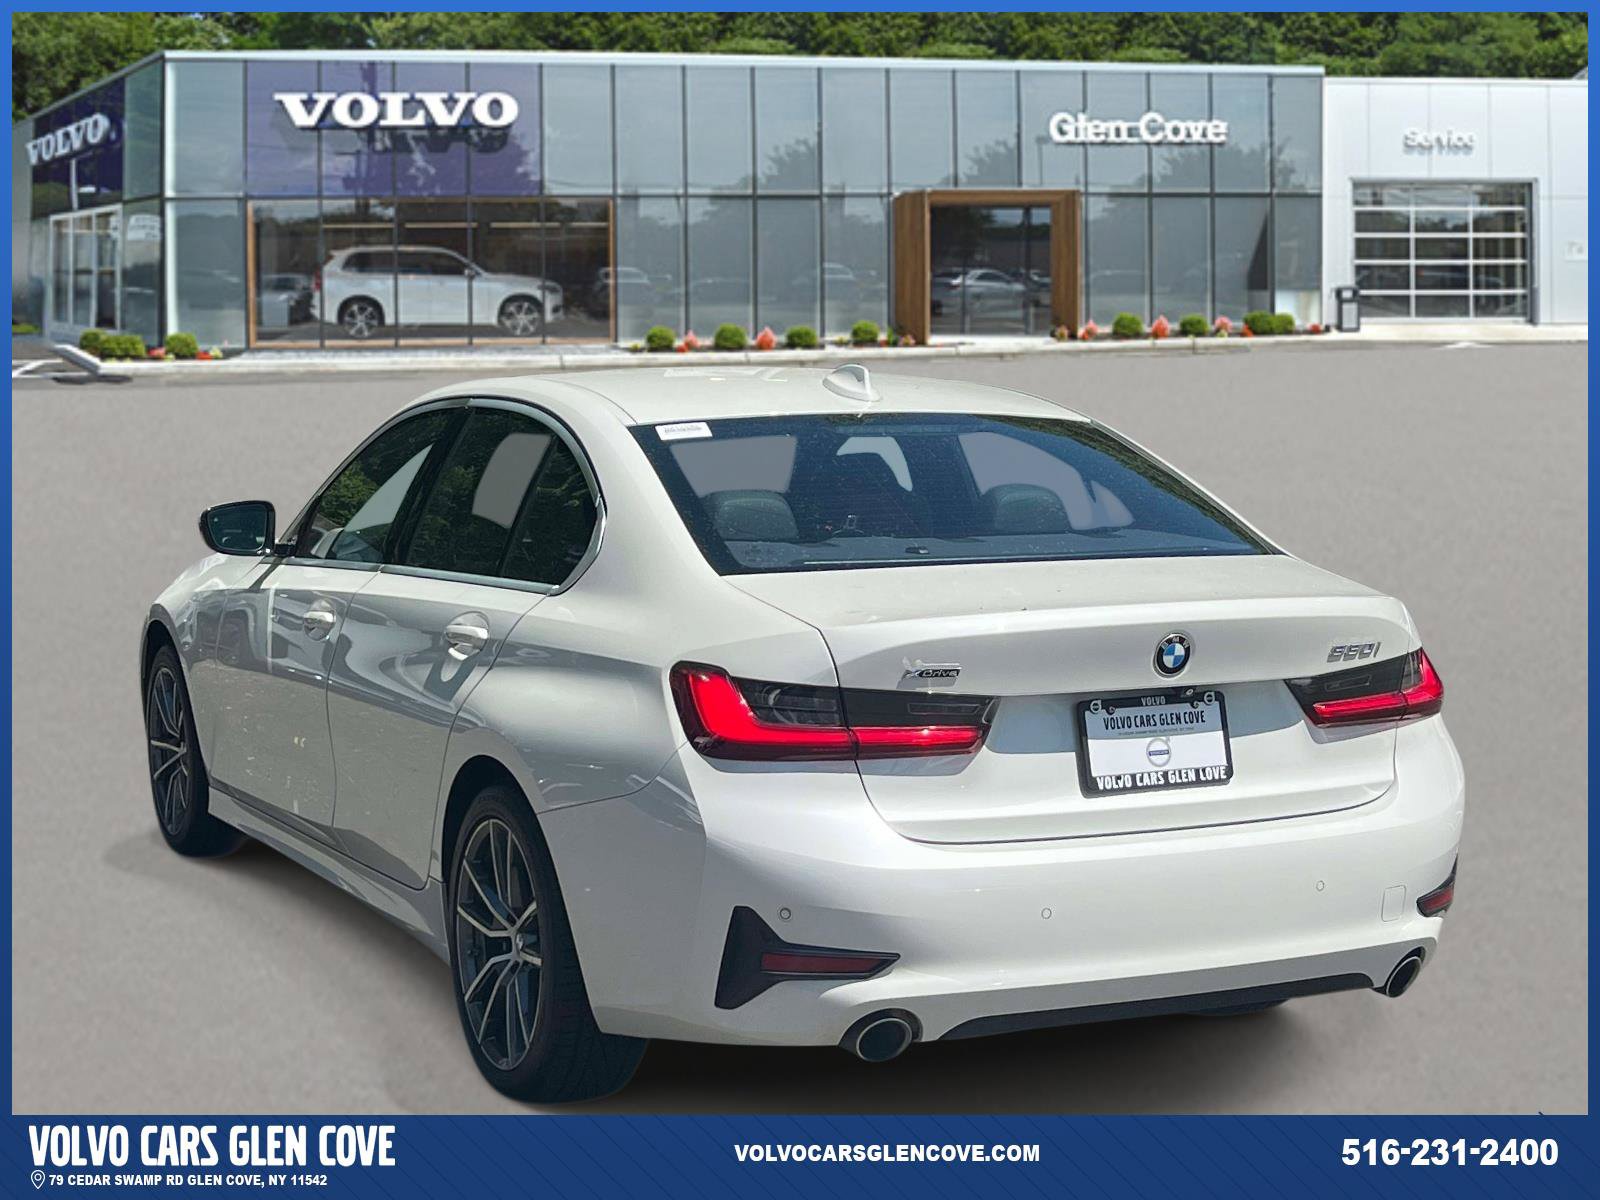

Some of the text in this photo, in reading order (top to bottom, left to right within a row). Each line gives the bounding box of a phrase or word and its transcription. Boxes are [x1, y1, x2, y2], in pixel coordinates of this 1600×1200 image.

[275, 92, 519, 127] VOLVO
[26, 113, 110, 165] VOLVO
[1049, 112, 1228, 144] Glen Cove
[1402, 127, 1476, 154] Service
[1141, 696, 1166, 706] VOLVO
[1103, 710, 1206, 730] VOLVO CARS GLEN COVE
[1096, 774, 1132, 790] VOLVO
[1136, 771, 1165, 786] CARS
[1168, 769, 1196, 783] GLEN
